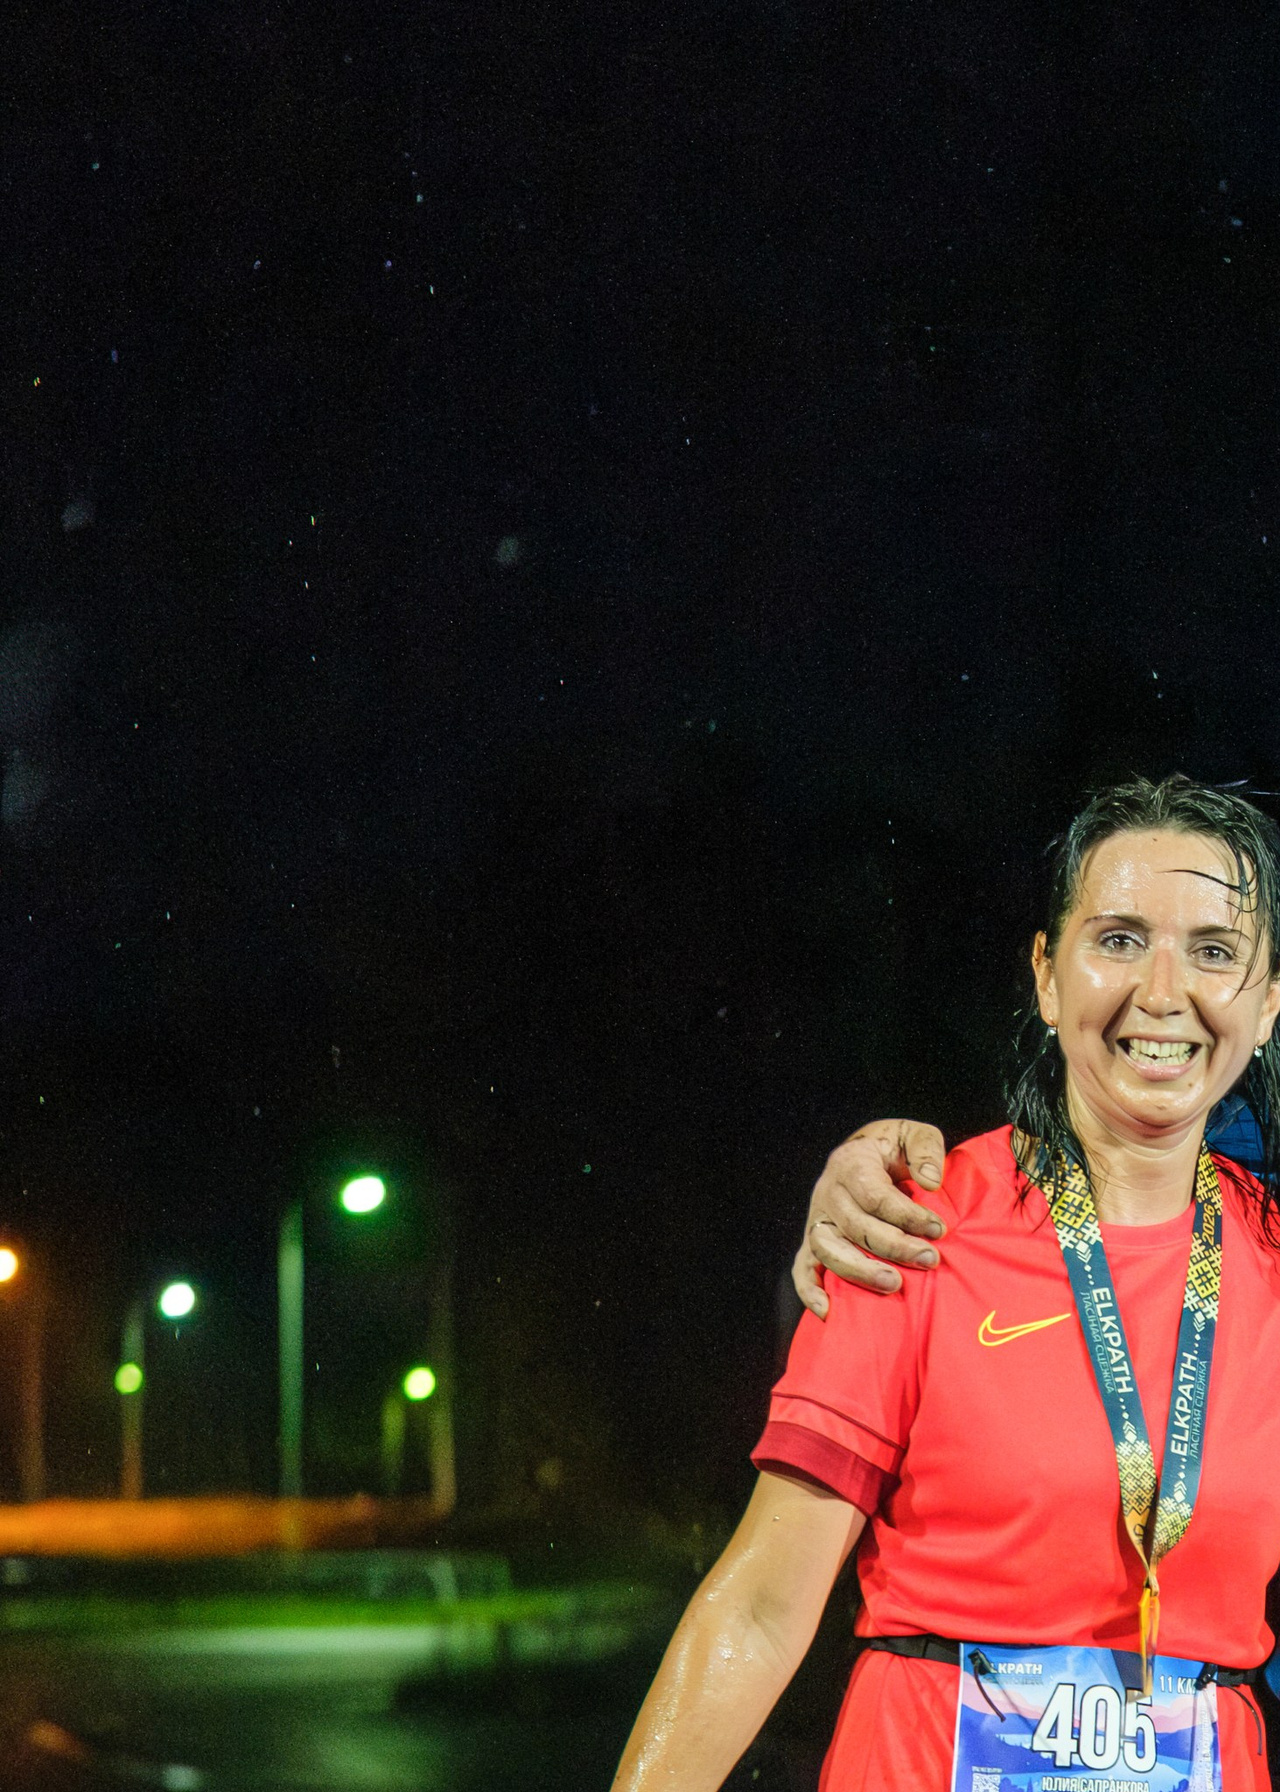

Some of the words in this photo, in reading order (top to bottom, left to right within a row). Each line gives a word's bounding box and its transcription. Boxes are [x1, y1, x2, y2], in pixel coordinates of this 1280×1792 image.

[1201, 1203, 1215, 1246] 2026
[1091, 1287, 1134, 1394] ELKPATH
[1170, 1352, 1198, 1456] ELKPATH
[1159, 1674, 1173, 1693] 11
[1032, 1683, 1157, 1774] 405
[1041, 1775, 1078, 1792] ЮЛИЯ
